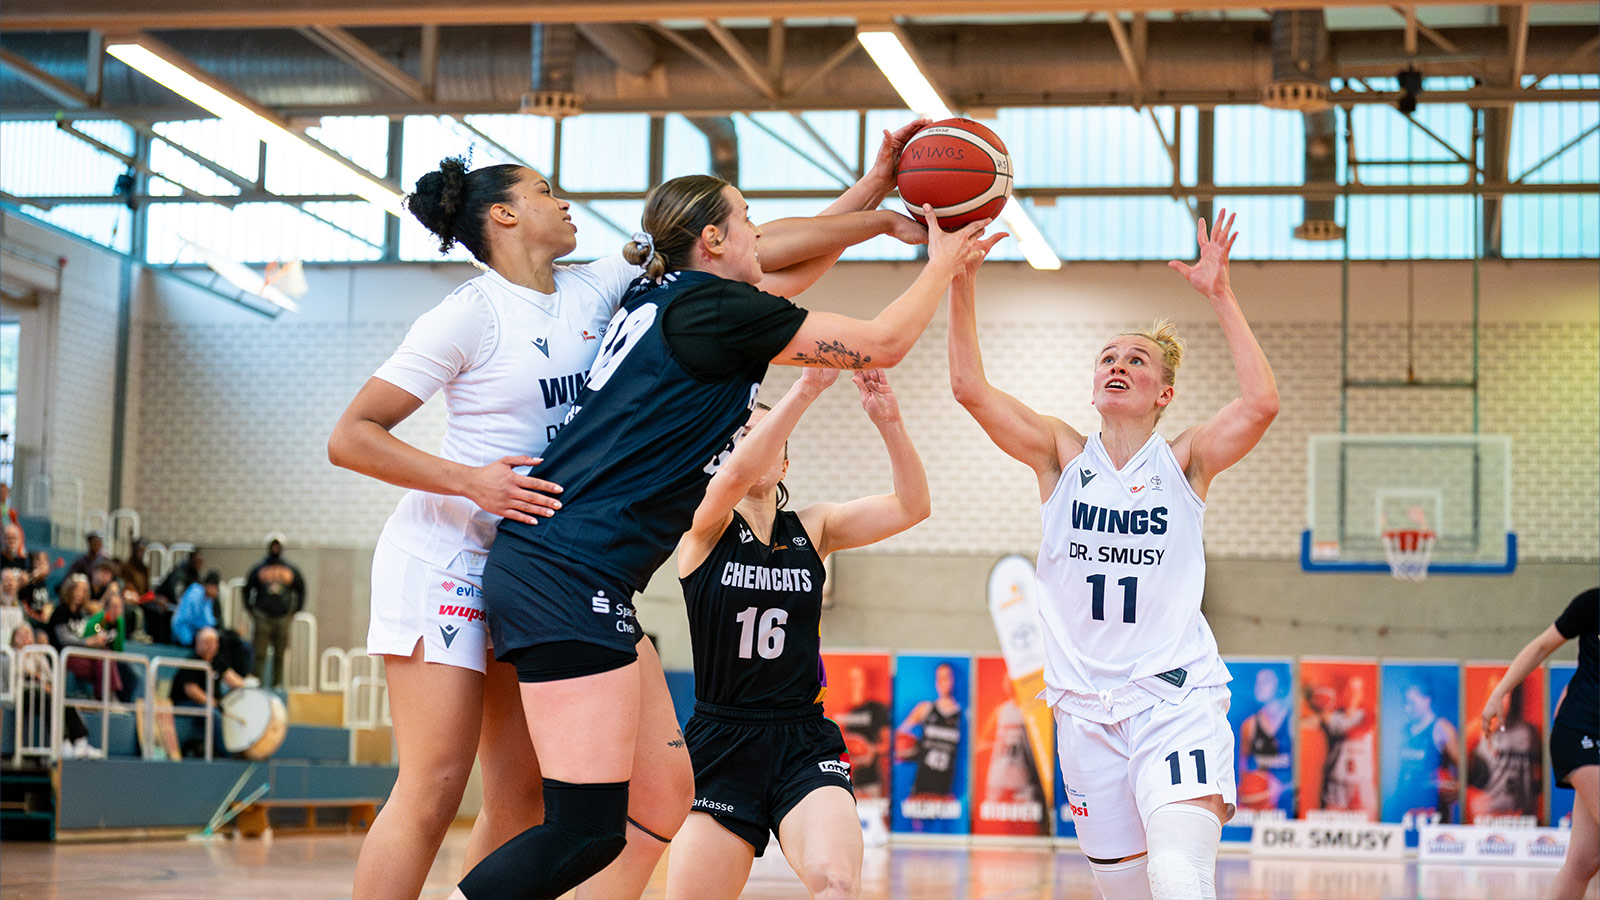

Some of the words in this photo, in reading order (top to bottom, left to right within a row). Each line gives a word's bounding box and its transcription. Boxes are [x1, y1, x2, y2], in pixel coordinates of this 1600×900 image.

[911, 145, 964, 160] WINGS
[1071, 499, 1168, 536] WINGS
[1069, 541, 1093, 562] DR.
[1097, 546, 1166, 566] SMUSY
[720, 561, 813, 593] CHEMCATS
[1086, 573, 1139, 624] 11
[736, 606, 789, 660] 16
[1164, 748, 1208, 786] 11
[1262, 827, 1301, 848] DR.
[1308, 828, 1394, 850] SMUSY
